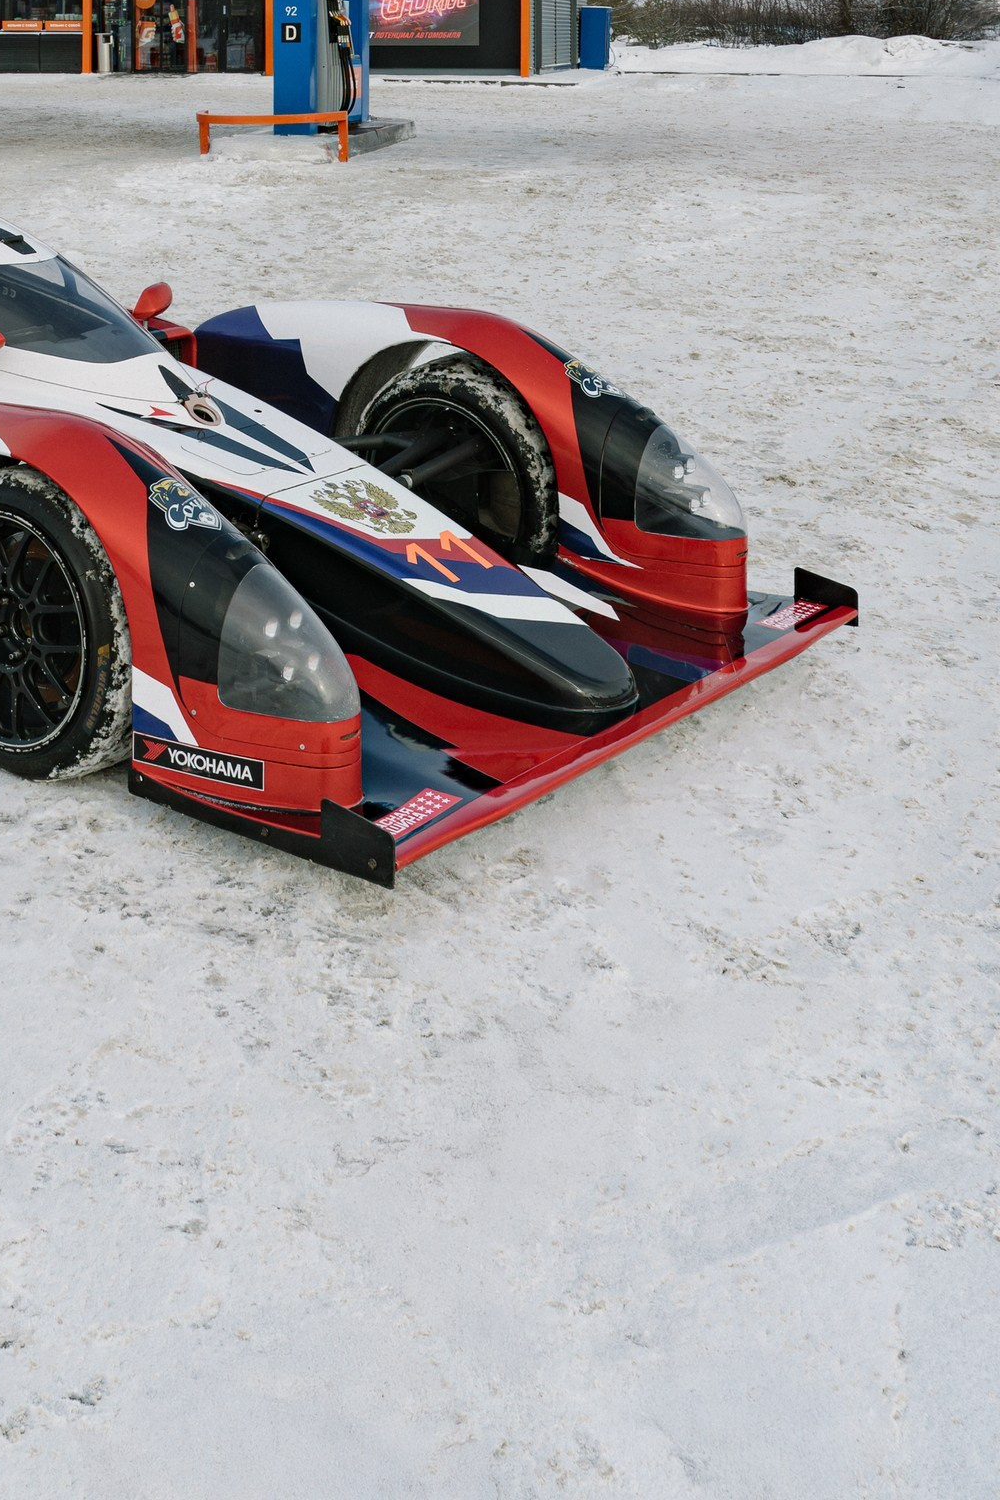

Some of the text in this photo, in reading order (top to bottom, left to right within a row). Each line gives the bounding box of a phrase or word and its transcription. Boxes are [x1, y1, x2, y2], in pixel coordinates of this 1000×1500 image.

[285, 6, 298, 17] 92
[285, 25, 297, 41] D
[374, 31, 414, 40] ПОТЕНЦИАЛ
[415, 31, 462, 39] АВТОМОБИЛЯ
[405, 529, 494, 583] 11
[167, 747, 254, 783] YOKOHAMA
